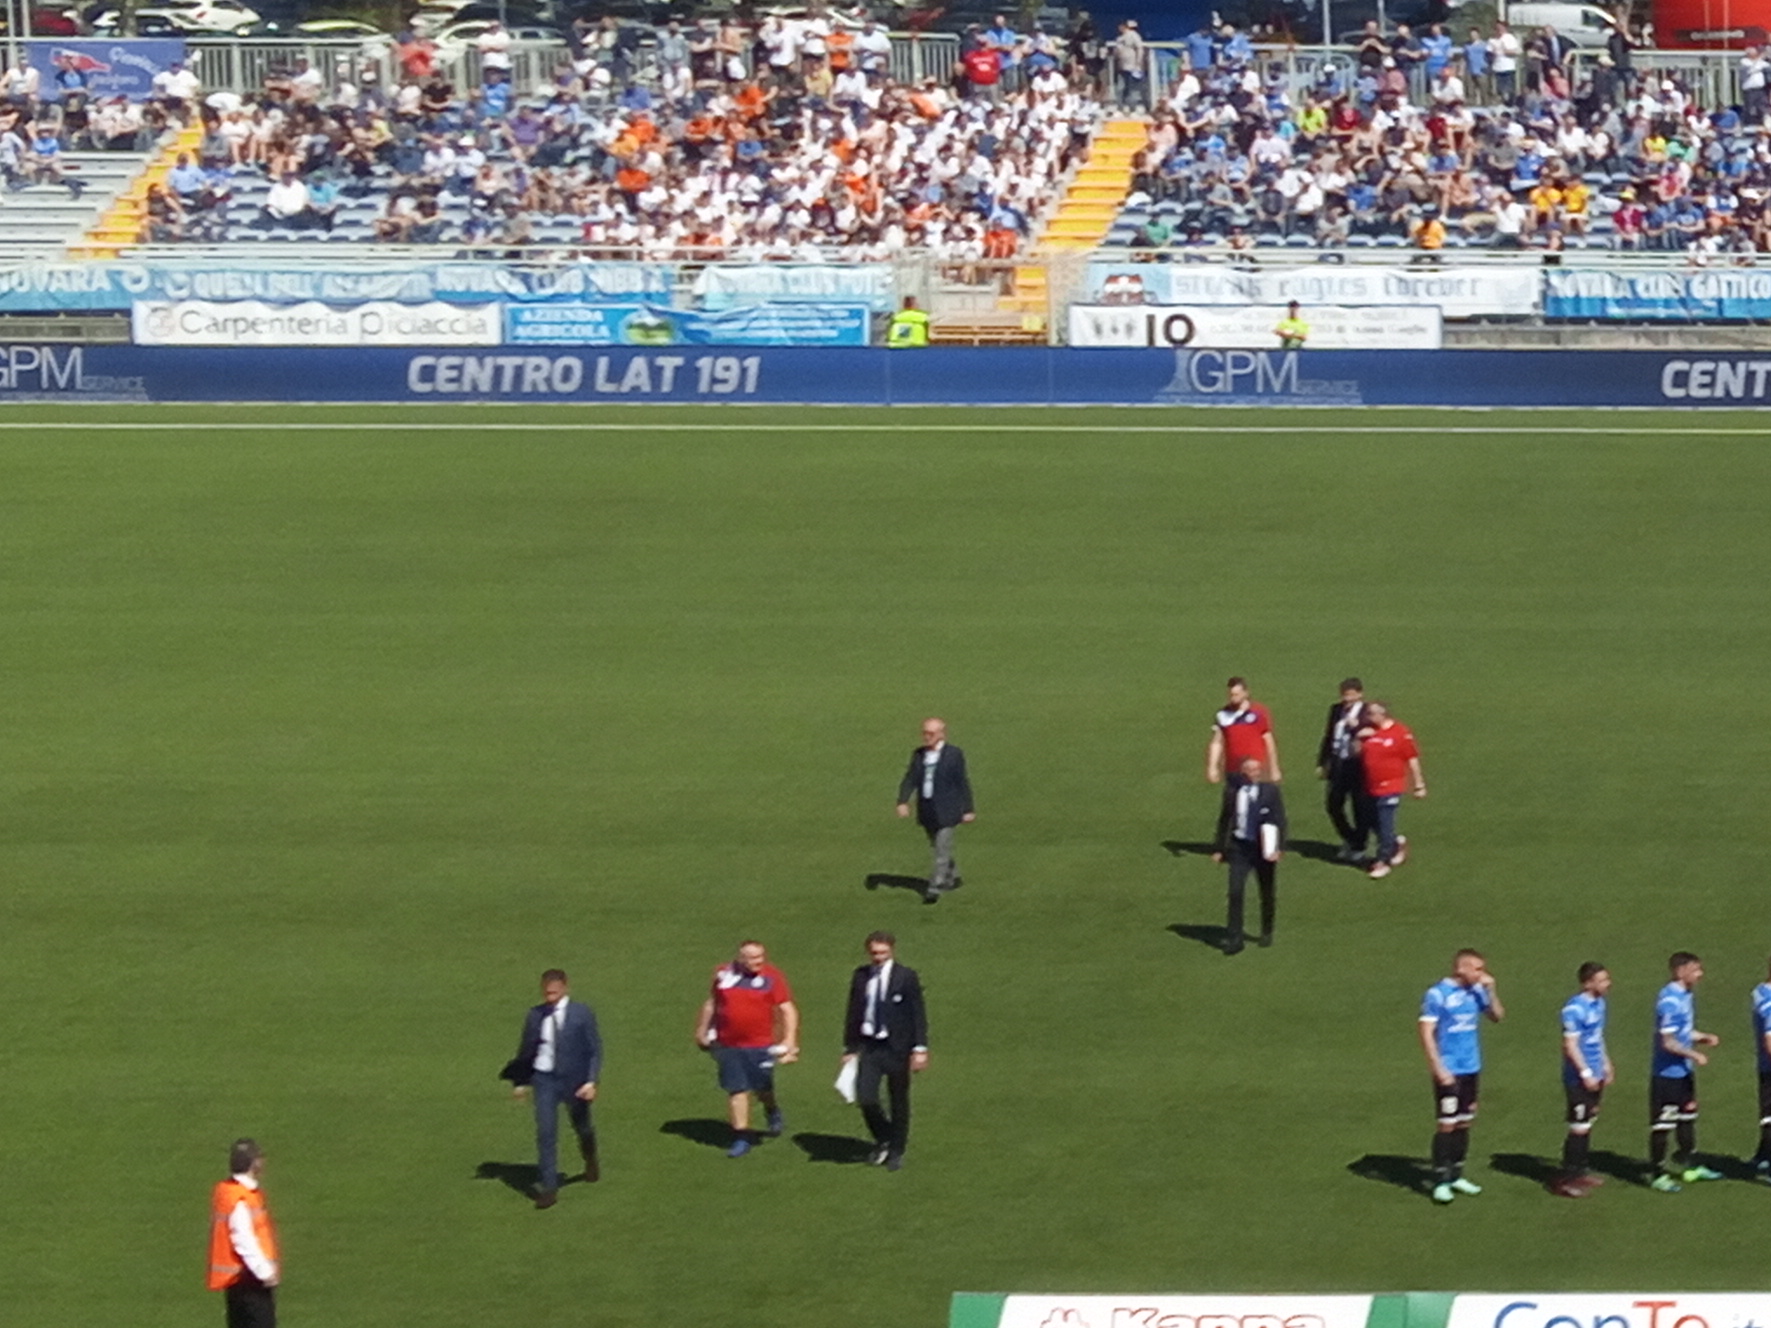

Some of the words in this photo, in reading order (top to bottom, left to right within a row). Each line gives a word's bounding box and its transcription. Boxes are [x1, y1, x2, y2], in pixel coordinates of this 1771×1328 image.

[180, 309, 349, 340] Carpenteria
[0, 346, 84, 391] PM
[407, 355, 583, 395] CENTRO
[594, 356, 685, 395] LAT
[696, 356, 762, 395] 191
[1189, 350, 1299, 394] GPM
